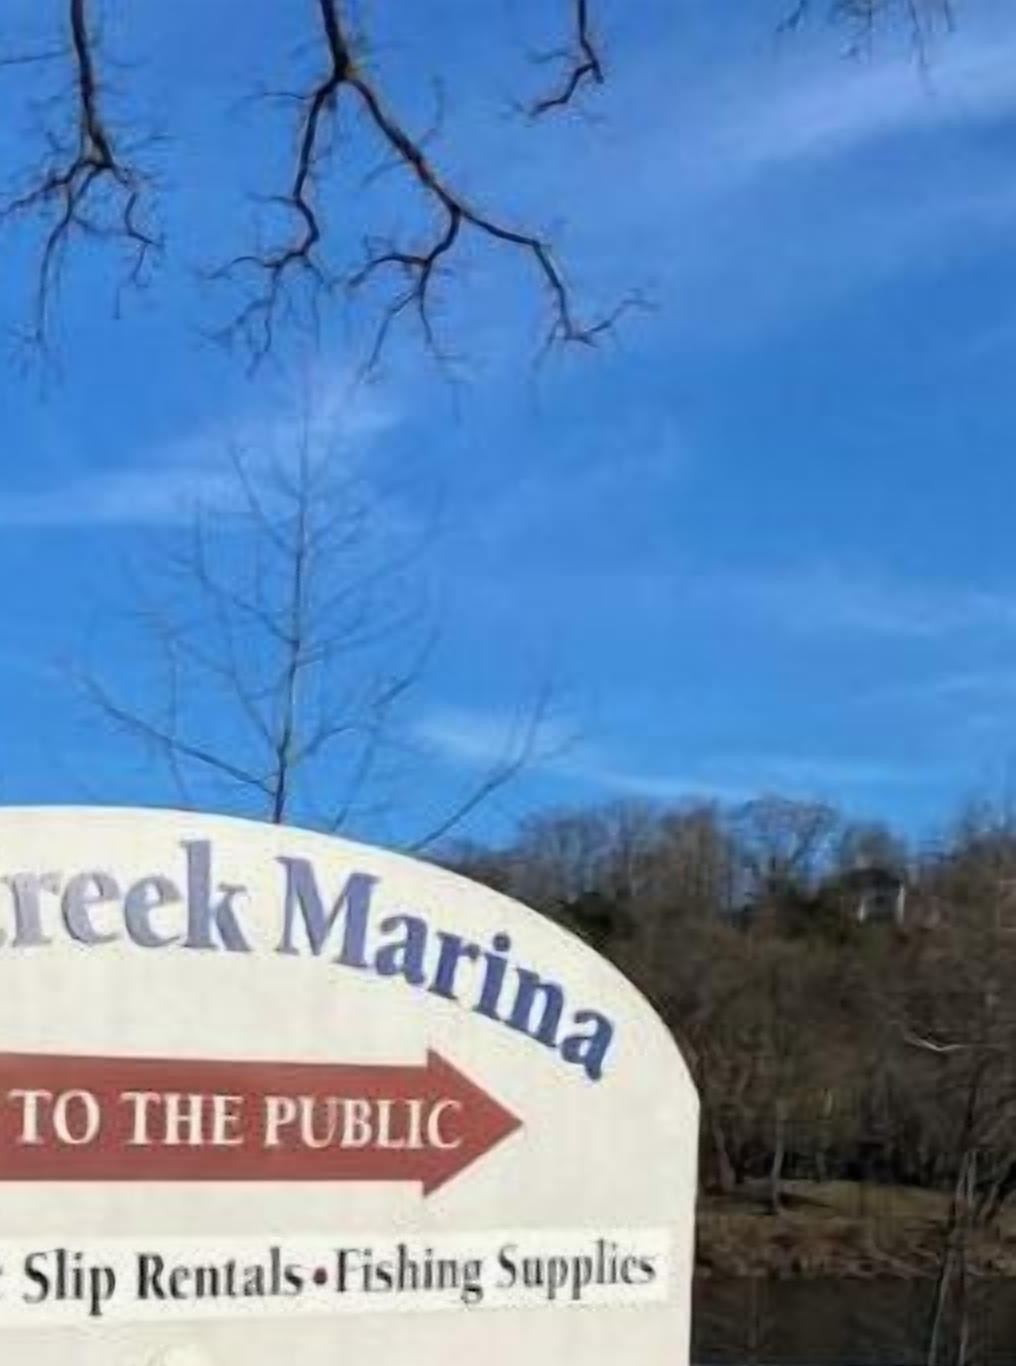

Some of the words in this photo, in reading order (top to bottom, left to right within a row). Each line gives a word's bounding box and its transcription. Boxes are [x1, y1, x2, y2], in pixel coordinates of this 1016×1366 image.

[275, 855, 617, 1082] Marina
[10, 1088, 102, 1146] TO
[120, 1091, 245, 1147] THE
[263, 1096, 463, 1150] PUBLIC
[22, 1248, 118, 1317] Slip
[136, 1247, 305, 1302] Rentals
[335, 1243, 484, 1304] Fishing
[496, 1239, 657, 1302] Supplies
